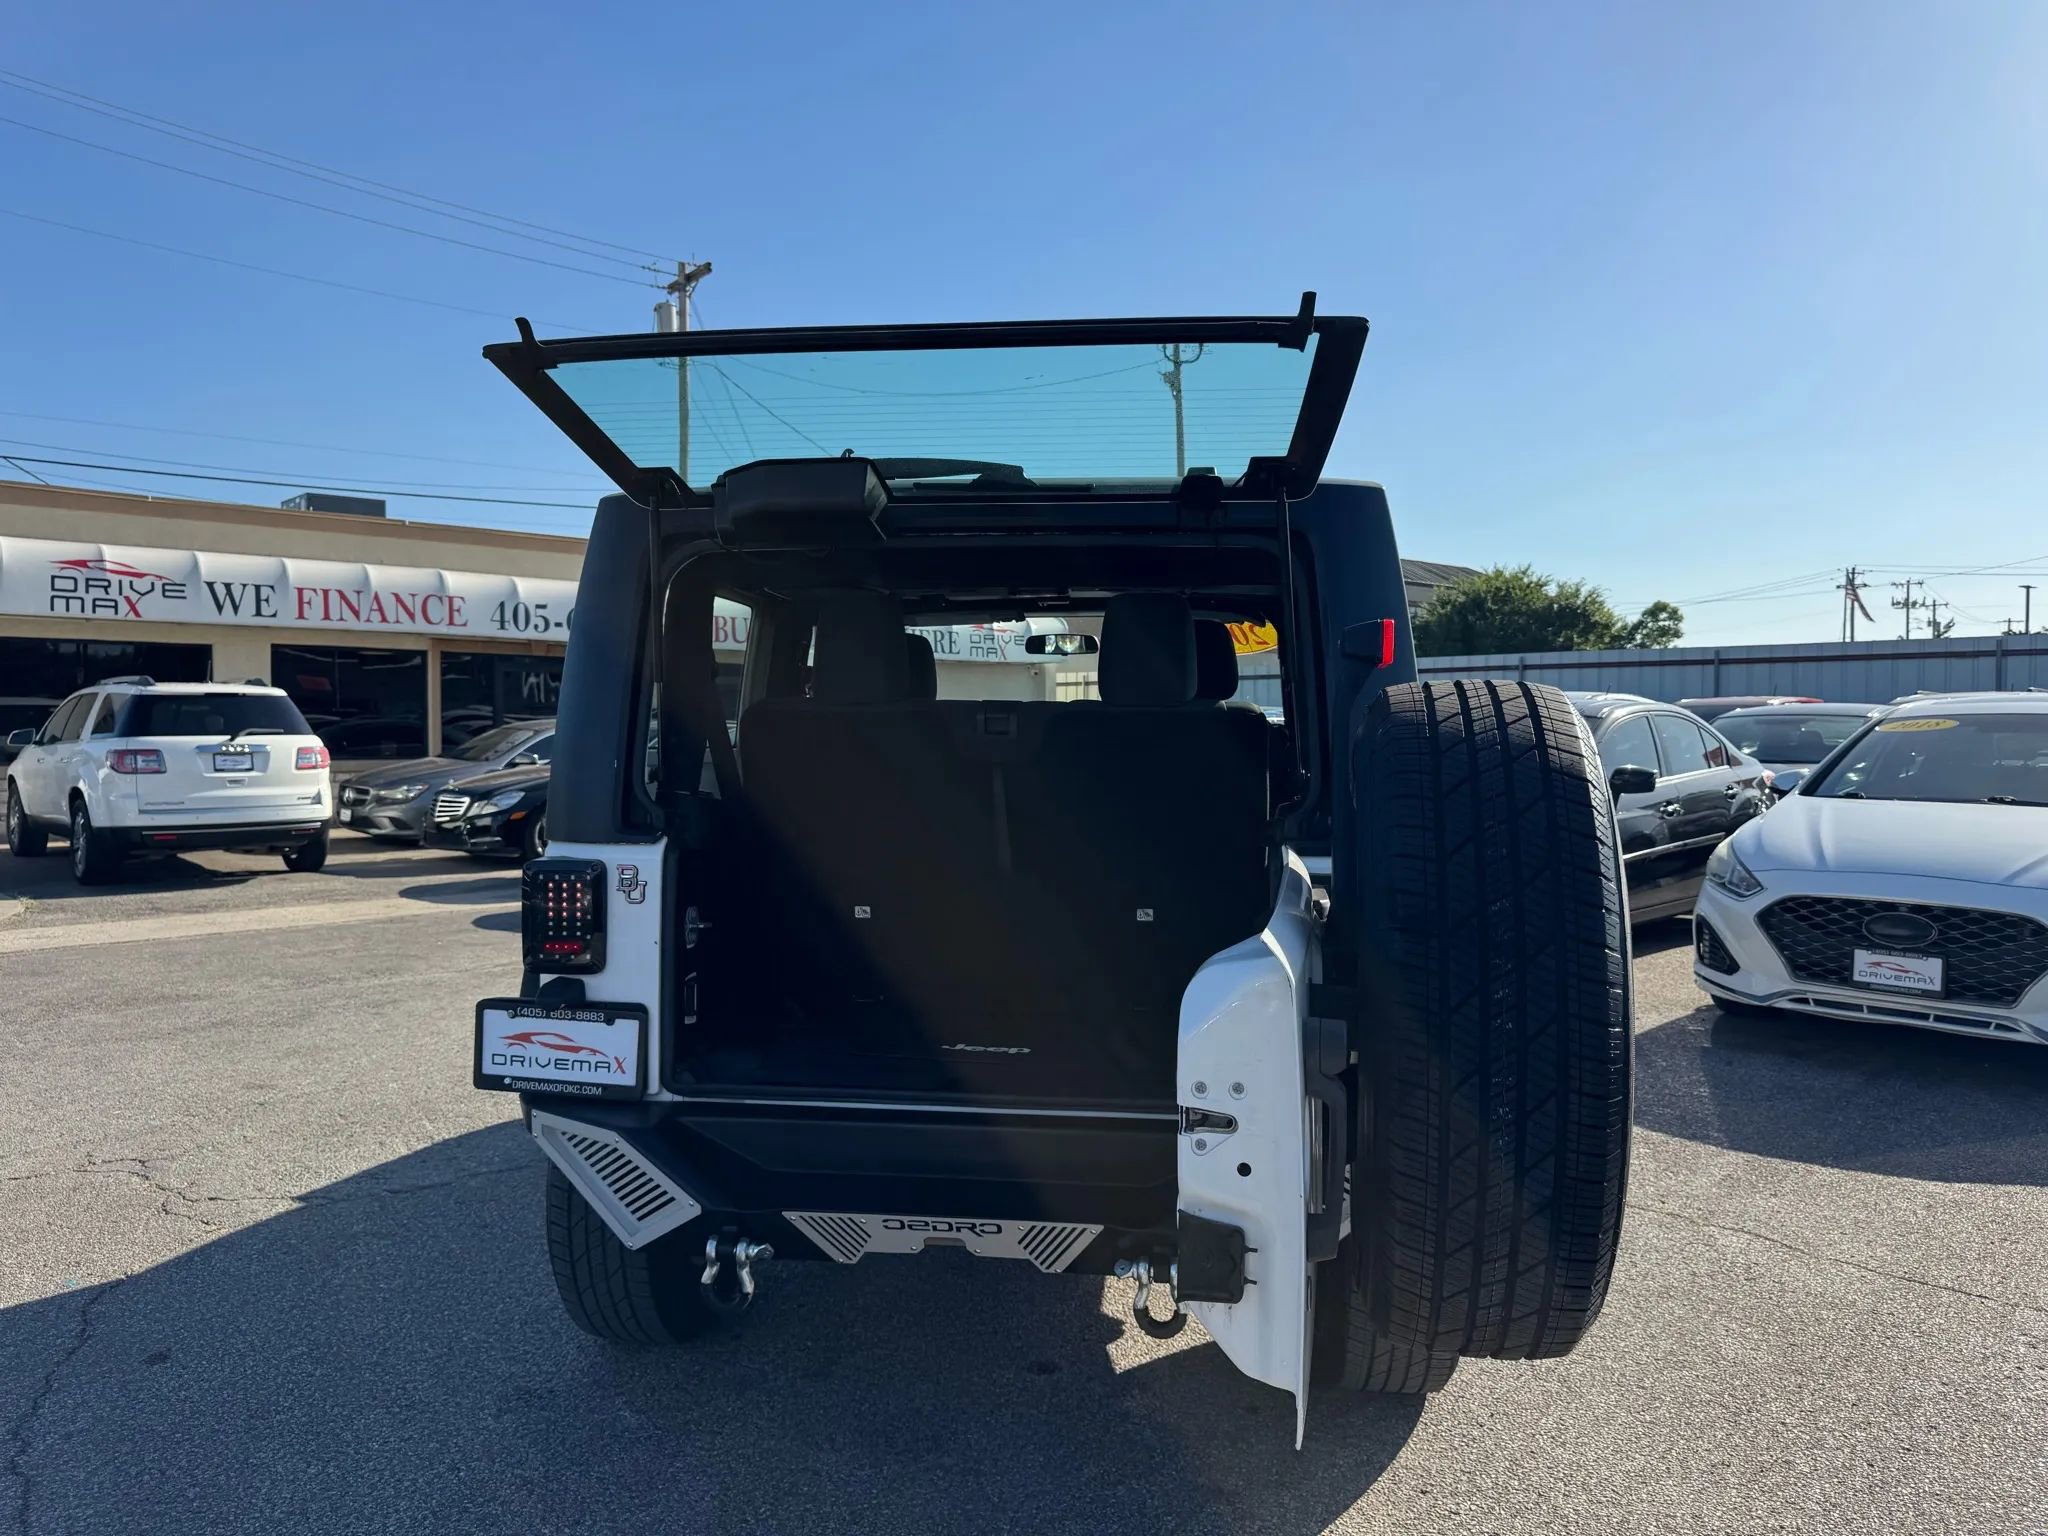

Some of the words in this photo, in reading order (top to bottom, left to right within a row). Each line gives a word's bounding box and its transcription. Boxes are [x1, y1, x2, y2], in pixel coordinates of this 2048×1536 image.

[50, 574, 187, 600] DRIVE
[50, 595, 142, 618] MAX
[203, 580, 278, 618] WE
[294, 586, 468, 627] FINANCE
[908, 628, 960, 655] RE
[969, 633, 1025, 646] DRIVE
[969, 644, 1008, 660] MAX
[1858, 970, 1936, 986] DRIVEMAX
[517, 1006, 547, 1018] (405)
[550, 1009, 605, 1022] 603-8883
[941, 1043, 1031, 1054] Jeep
[491, 1053, 627, 1075] DRIVEMAX
[512, 1079, 602, 1095] DRIVEMAXOFOKC.COM
